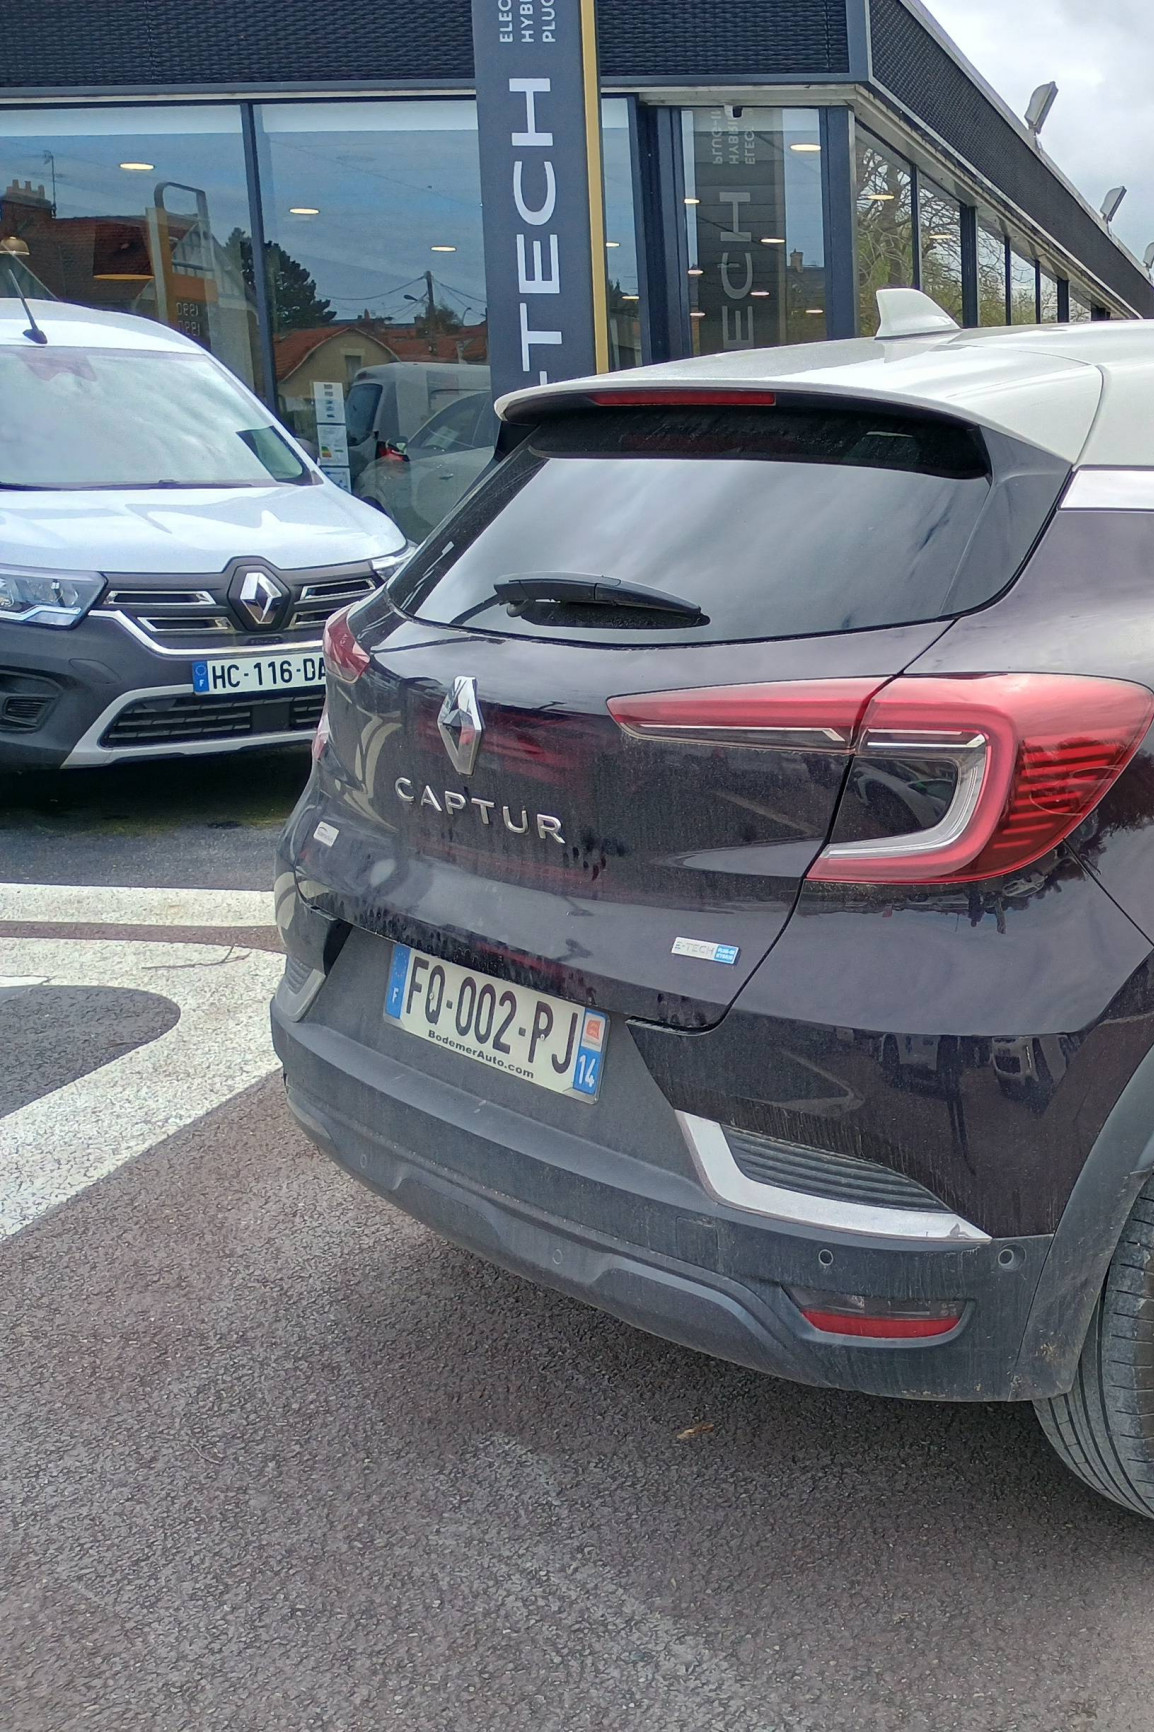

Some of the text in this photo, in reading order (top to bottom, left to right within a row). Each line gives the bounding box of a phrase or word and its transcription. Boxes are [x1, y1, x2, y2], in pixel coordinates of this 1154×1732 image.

[520, 0, 534, 42] HYB
[394, 777, 566, 844] CAPTUR
[391, 986, 399, 1003] F
[406, 956, 579, 1075] FQ-002-PJ
[427, 1029, 535, 1080] BodemerAuto.com
[577, 1054, 596, 1088] 14
